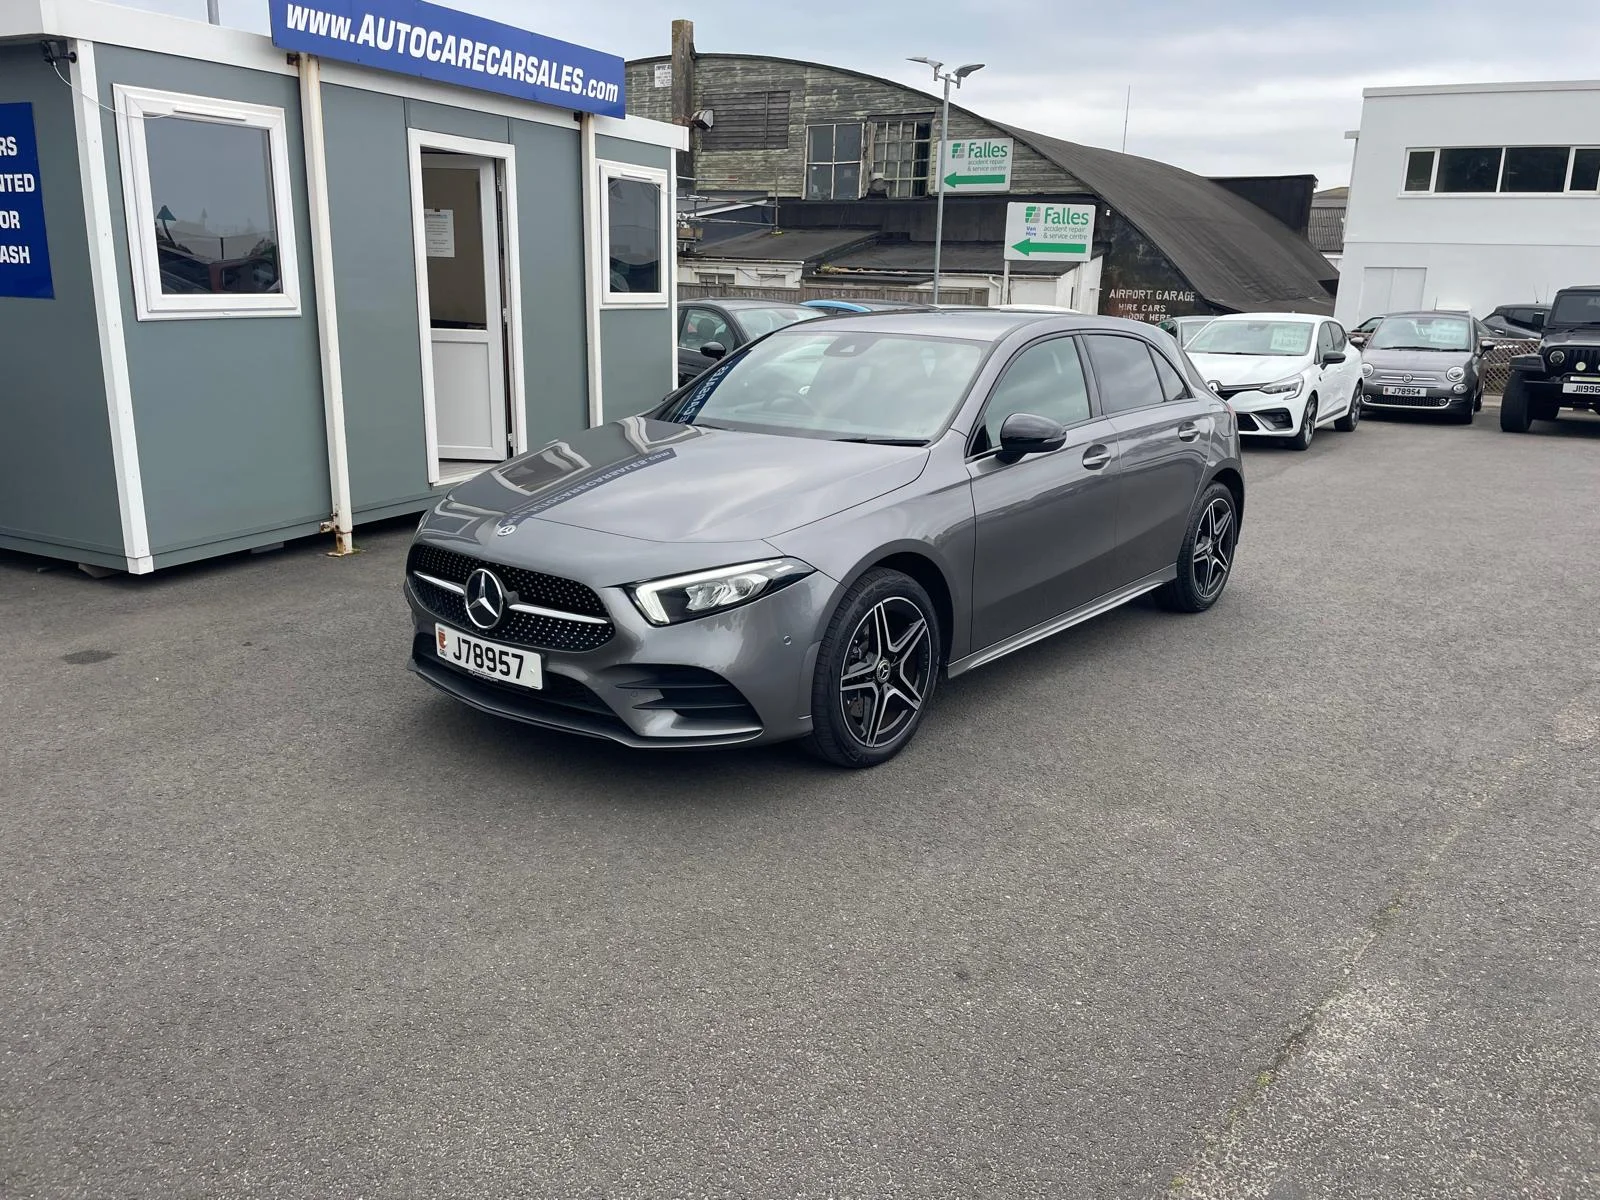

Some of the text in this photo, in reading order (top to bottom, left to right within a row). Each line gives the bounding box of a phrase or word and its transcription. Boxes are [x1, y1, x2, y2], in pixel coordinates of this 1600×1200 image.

[968, 141, 1008, 158] Falles
[1044, 207, 1089, 225] Falles
[1109, 289, 1195, 302] AIRPORT GARAGE
[1119, 303, 1138, 311] HIRE
[453, 636, 524, 679] J78957
